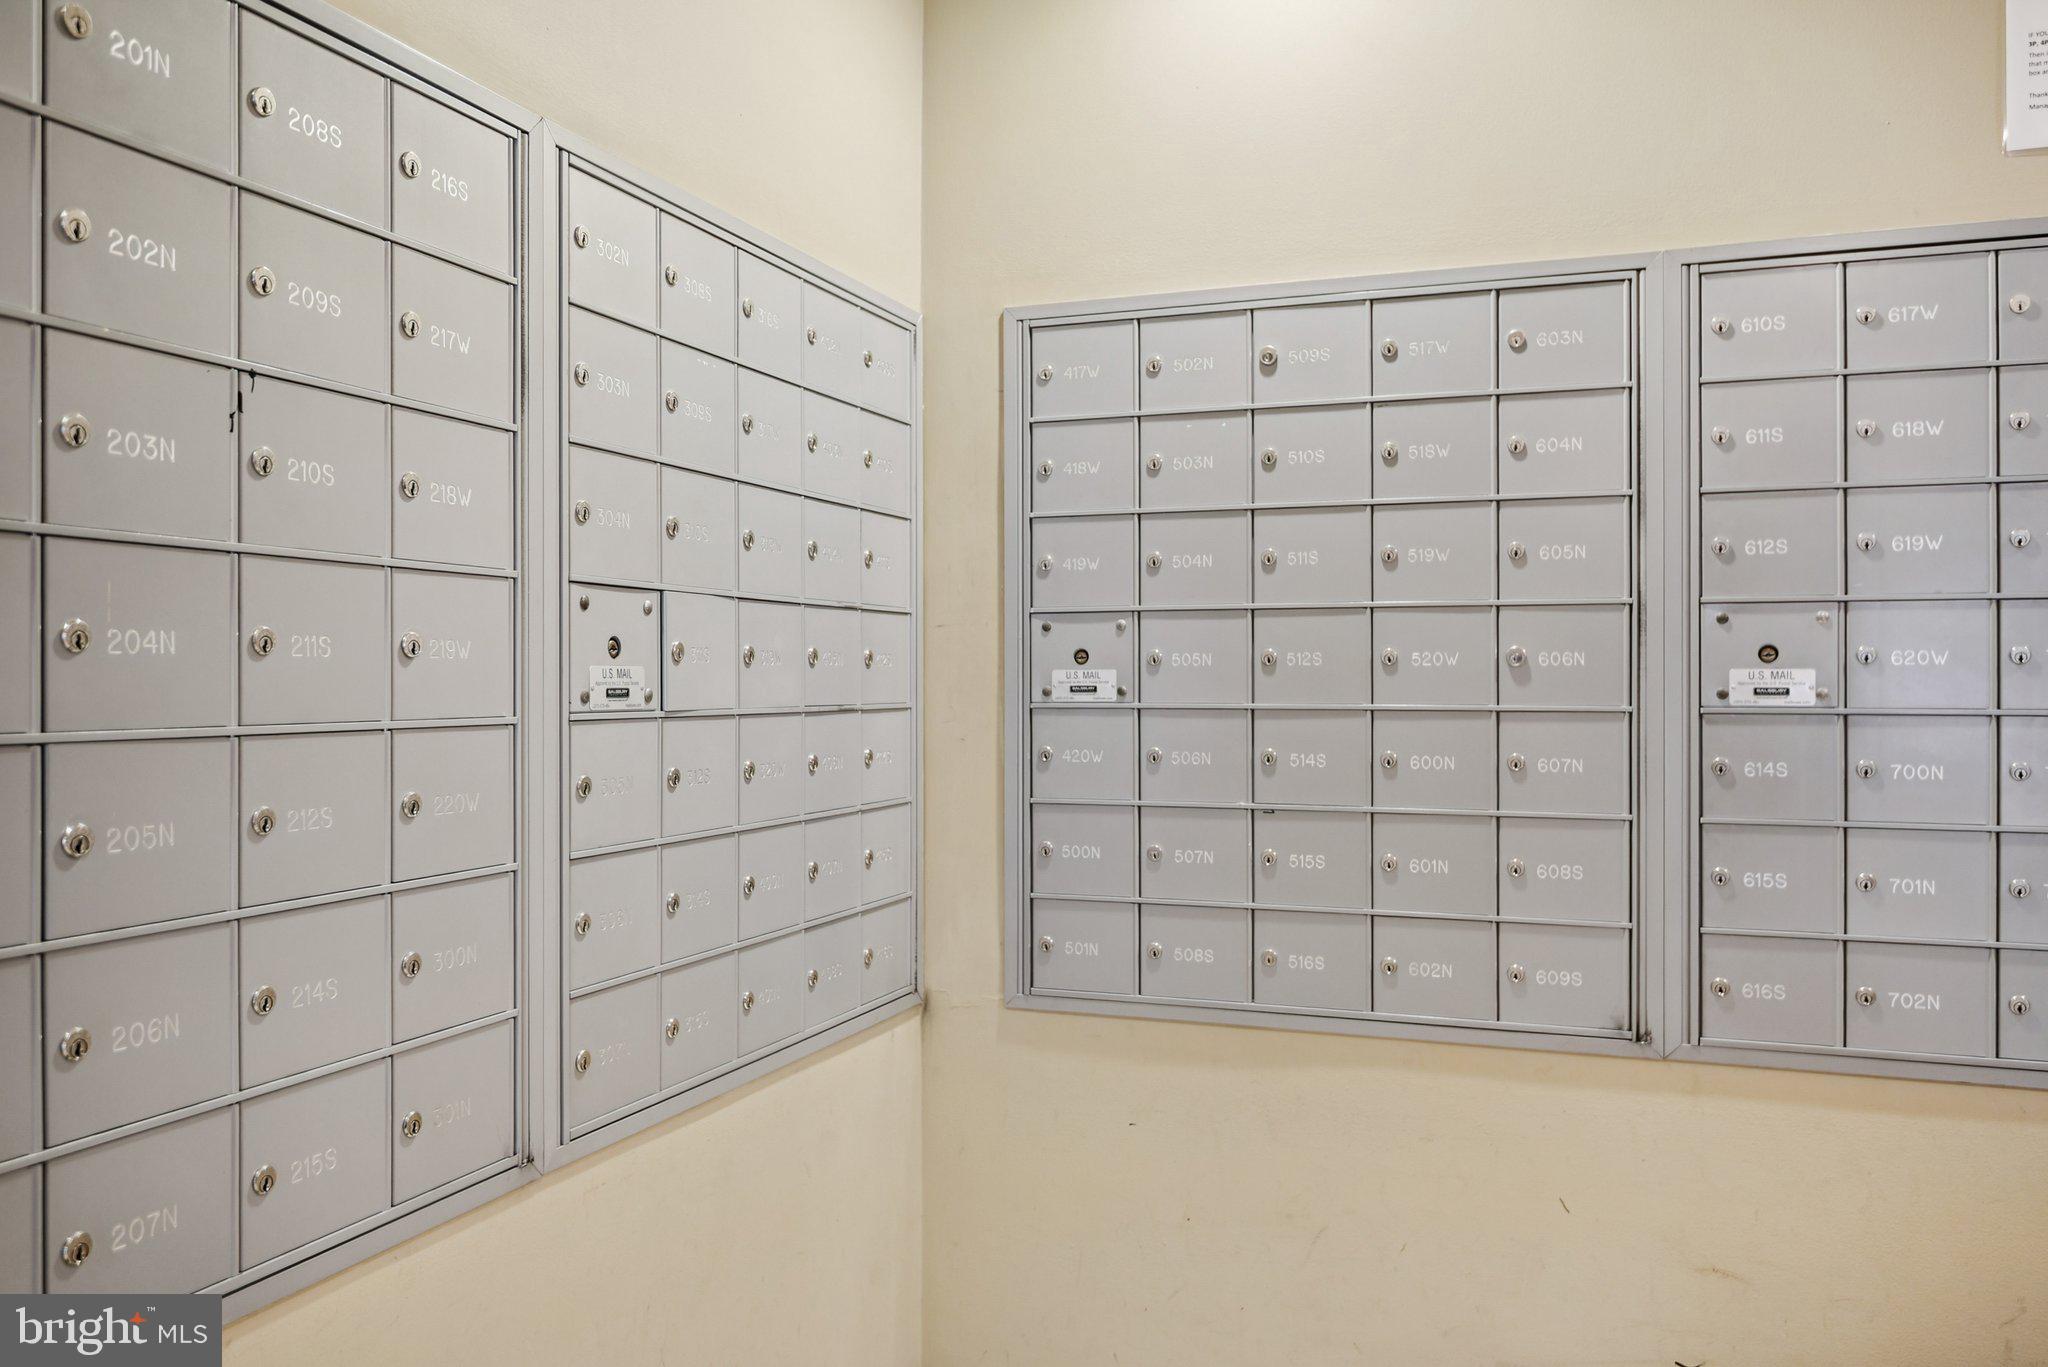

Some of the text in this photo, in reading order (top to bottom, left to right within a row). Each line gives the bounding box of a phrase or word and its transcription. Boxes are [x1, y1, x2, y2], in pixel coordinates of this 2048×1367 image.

[108, 29, 171, 79] 201N
[288, 106, 343, 150] 208S
[431, 167, 468, 202] 216S
[108, 227, 176, 272] 202N
[597, 238, 630, 267] 302N
[684, 276, 712, 302] 308S
[288, 281, 342, 318] 209S
[1888, 304, 1938, 322] 617W
[1741, 315, 1785, 333] 610S
[430, 325, 471, 355] 217W
[1537, 330, 1583, 347] 603N
[1288, 348, 1330, 364] 509S
[1408, 339, 1450, 357] 517W
[1063, 364, 1100, 380] 417W
[1173, 356, 1214, 372] 502N
[597, 372, 631, 399] 303N
[1745, 427, 1783, 445] 611S
[1892, 420, 1944, 437] 618W
[107, 428, 176, 465] 203N
[1408, 442, 1451, 459] 518W
[1536, 437, 1582, 453] 604N
[1173, 455, 1213, 470] 503N
[1288, 449, 1325, 465] 510S
[287, 458, 336, 487] 210S
[1063, 460, 1100, 476] 418W
[430, 481, 472, 509] 218W
[1744, 539, 1787, 555] 612S
[1892, 534, 1943, 551] 619W
[1172, 553, 1212, 568] 504N
[1287, 551, 1318, 566] 511S
[1408, 547, 1450, 563] 519W
[1539, 544, 1586, 560] 605N
[1063, 556, 1100, 571] 419W
[107, 630, 176, 655] 204N
[290, 633, 331, 658] 211S
[429, 638, 472, 662] 219W
[1171, 653, 1212, 668] 505N
[1286, 652, 1322, 667] 512S
[1411, 652, 1459, 667] 520W
[1538, 651, 1585, 667] 606N
[1891, 650, 1949, 666] 620W
[602, 668, 632, 679] U.S. MAIL
[1065, 671, 1102, 680] U.S. MAIL
[1748, 670, 1796, 681] U.S. MAIL
[1062, 749, 1104, 764] 420W
[1171, 751, 1211, 766] 506N
[1289, 754, 1326, 768] 514S
[1410, 756, 1455, 770] 600N
[1537, 758, 1583, 773] 607N
[1743, 762, 1788, 778] 614S
[1890, 764, 1944, 781] 700N
[432, 793, 480, 816] 220W
[287, 808, 334, 833] 212S
[107, 822, 176, 854] 205N
[1061, 844, 1101, 859] 500N
[1174, 849, 1214, 864] 507N
[1289, 853, 1325, 869] 515S
[1409, 858, 1448, 874] 601N
[1536, 864, 1583, 880] 608S
[1743, 872, 1787, 889] 615S
[1889, 878, 1935, 895] 701N
[1064, 941, 1099, 957] 501N
[1173, 948, 1214, 964] 508S
[431, 943, 479, 974] 300N
[1288, 954, 1325, 971] 516S
[1408, 962, 1453, 979] 602N
[1535, 969, 1582, 986] 609S
[290, 976, 340, 1010] 214S
[1742, 984, 1786, 1000] 616S
[1889, 993, 1940, 1010] 702N
[111, 1012, 180, 1054] 206N
[290, 1145, 337, 1186] 215S
[111, 1202, 179, 1253] 207N
